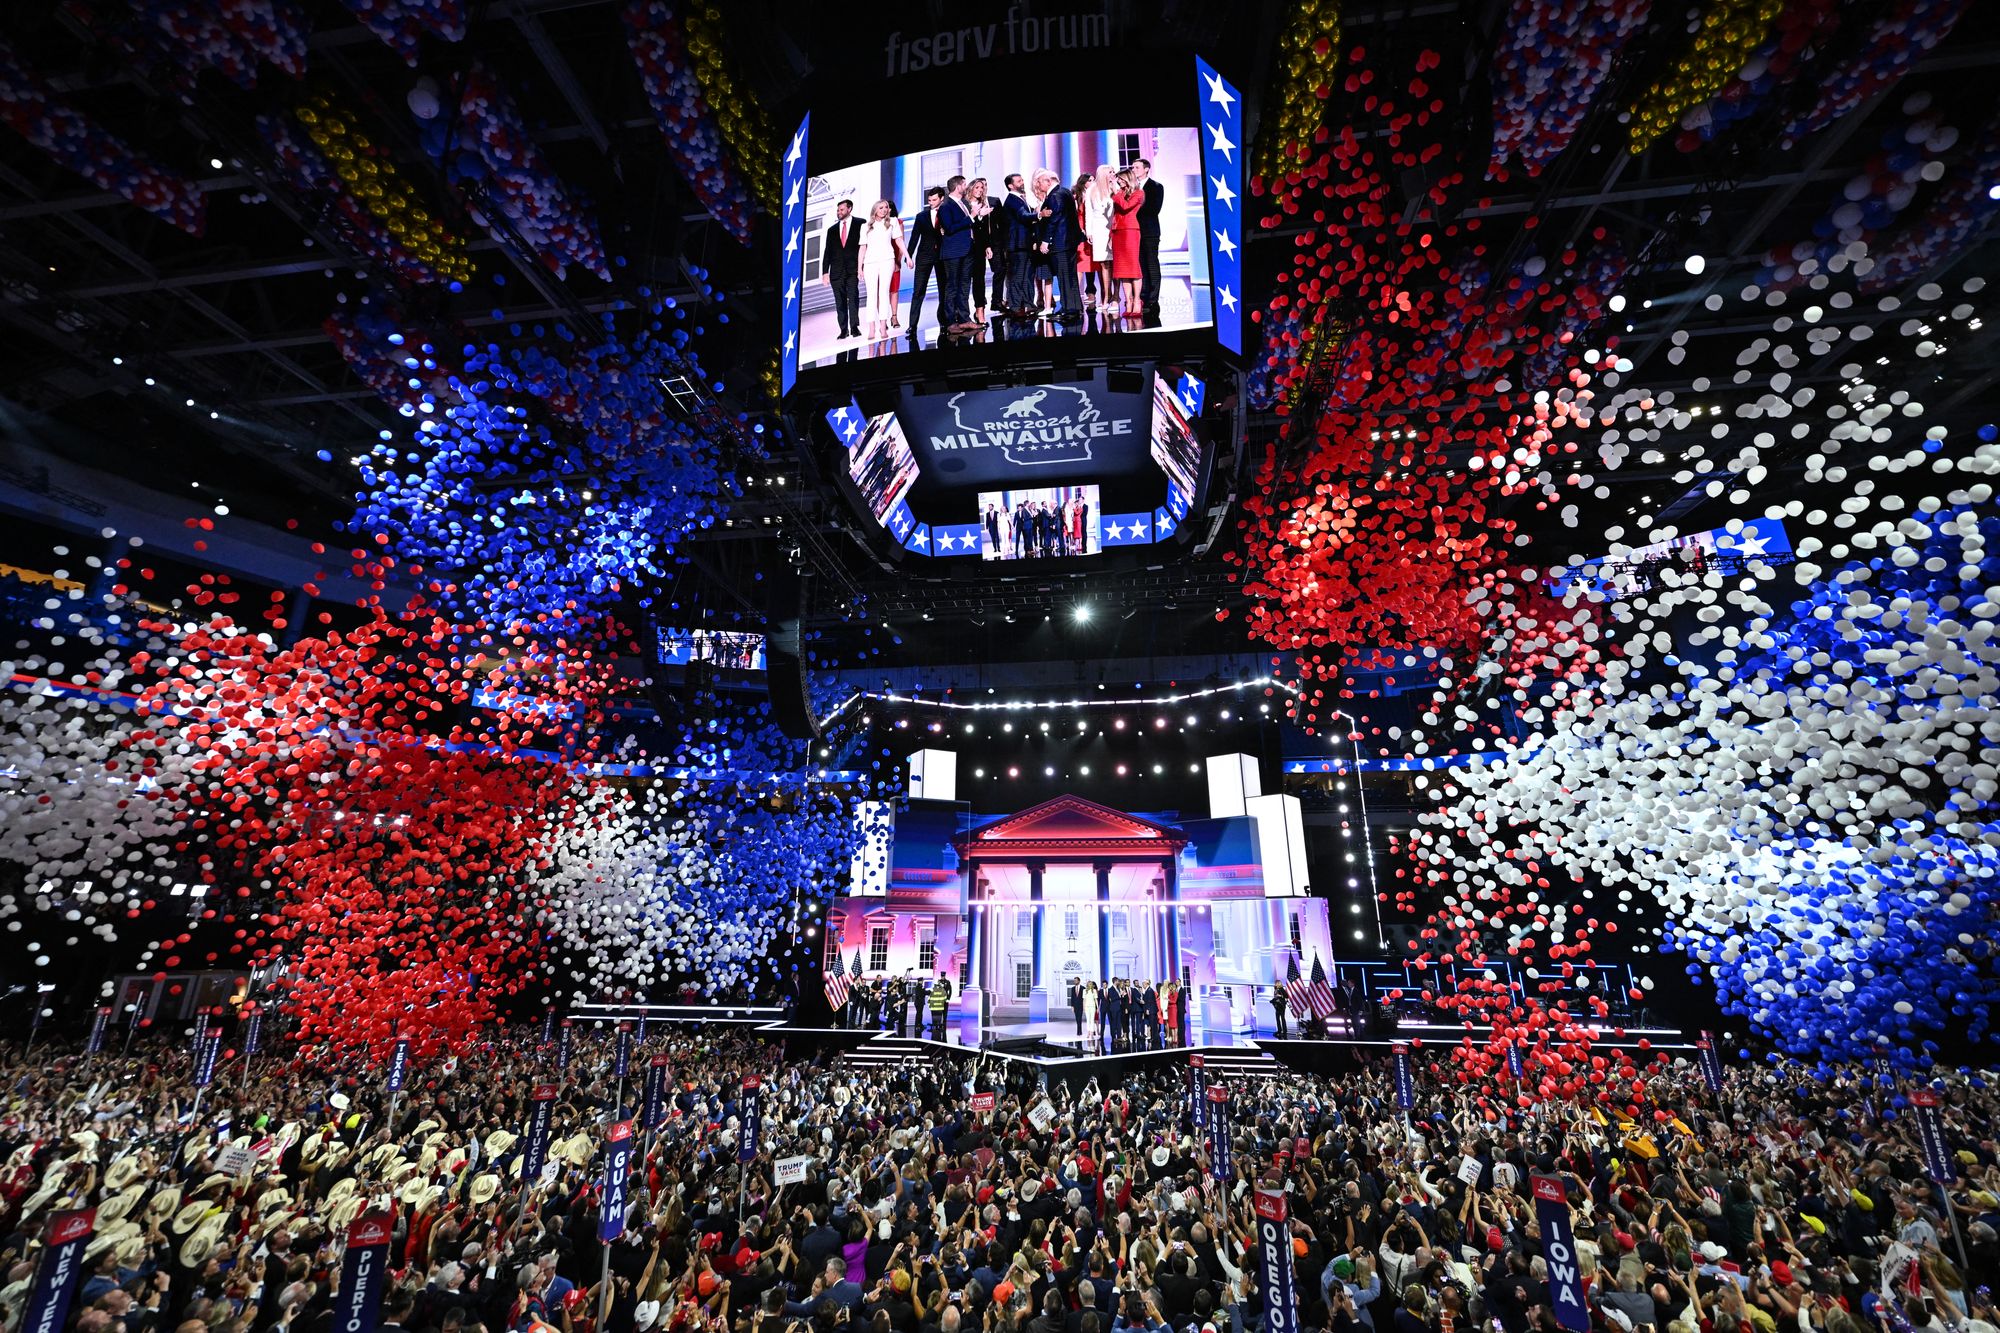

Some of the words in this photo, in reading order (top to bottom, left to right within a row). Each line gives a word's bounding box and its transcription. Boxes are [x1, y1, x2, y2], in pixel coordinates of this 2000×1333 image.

[885, 23, 997, 78] fiserv
[1004, 6, 1110, 54] forum
[930, 419, 1133, 451] MILWAUKEE
[984, 420, 1021, 431] RNC
[1024, 416, 1072, 428] 2024
[196, 1038, 211, 1084] ALABAMA
[391, 1043, 406, 1087] TEXAS
[1398, 1054, 1408, 1107] PENNSYLVANIA
[1880, 1058, 1895, 1090] OHO
[743, 1096, 755, 1150] MAINE
[1194, 1067, 1203, 1124] FLORIDA
[528, 1101, 547, 1175] KENTUCKY
[777, 1161, 804, 1172] TRUMP
[1212, 1103, 1221, 1176] INDIANA
[1222, 1103, 1231, 1176] INDIANA
[1925, 1107, 1952, 1180] MINNESOTA
[599, 1152, 611, 1223] GUAM
[609, 1151, 626, 1223] GUAM
[780, 1168, 801, 1177] VANCE
[50, 1242, 76, 1290] NEW
[346, 1250, 373, 1333] PUERTO
[1282, 1222, 1299, 1333] OREGO
[1550, 1221, 1579, 1307] IOWA
